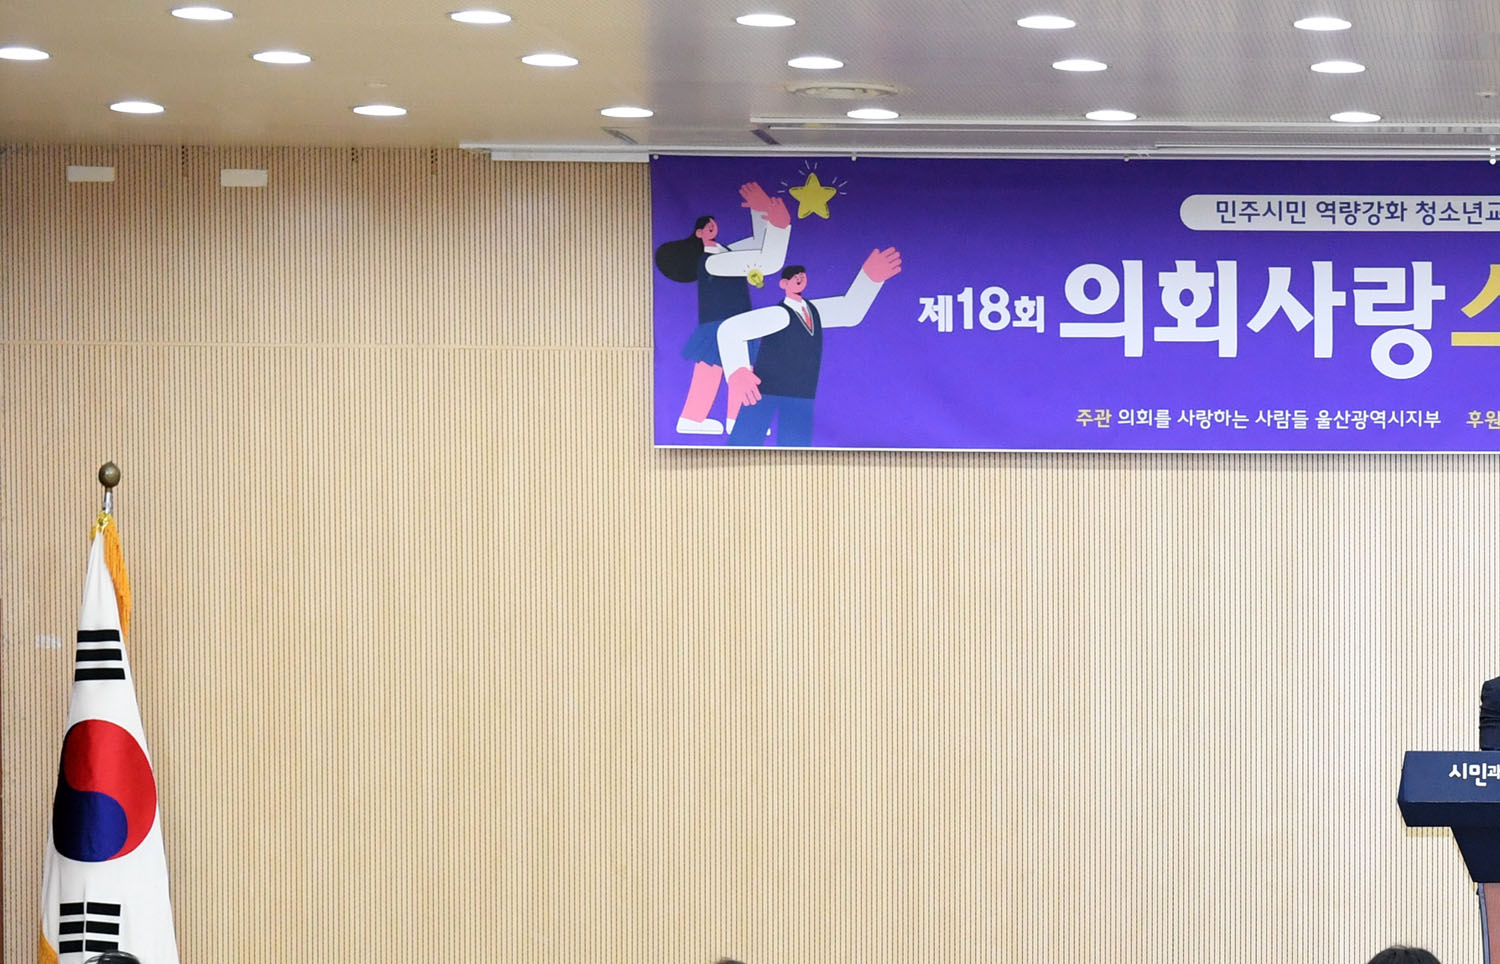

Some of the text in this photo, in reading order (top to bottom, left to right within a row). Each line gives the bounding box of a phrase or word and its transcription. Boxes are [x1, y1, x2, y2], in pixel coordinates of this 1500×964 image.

[1216, 200, 1306, 225] 민주시민
[1316, 200, 1408, 226] 역량강화
[917, 286, 1045, 334] 제18회
[1075, 408, 1442, 431] 주관 의회를 사랑하는 사람들 울산광역시지부
[1465, 410, 1500, 430] 후원
